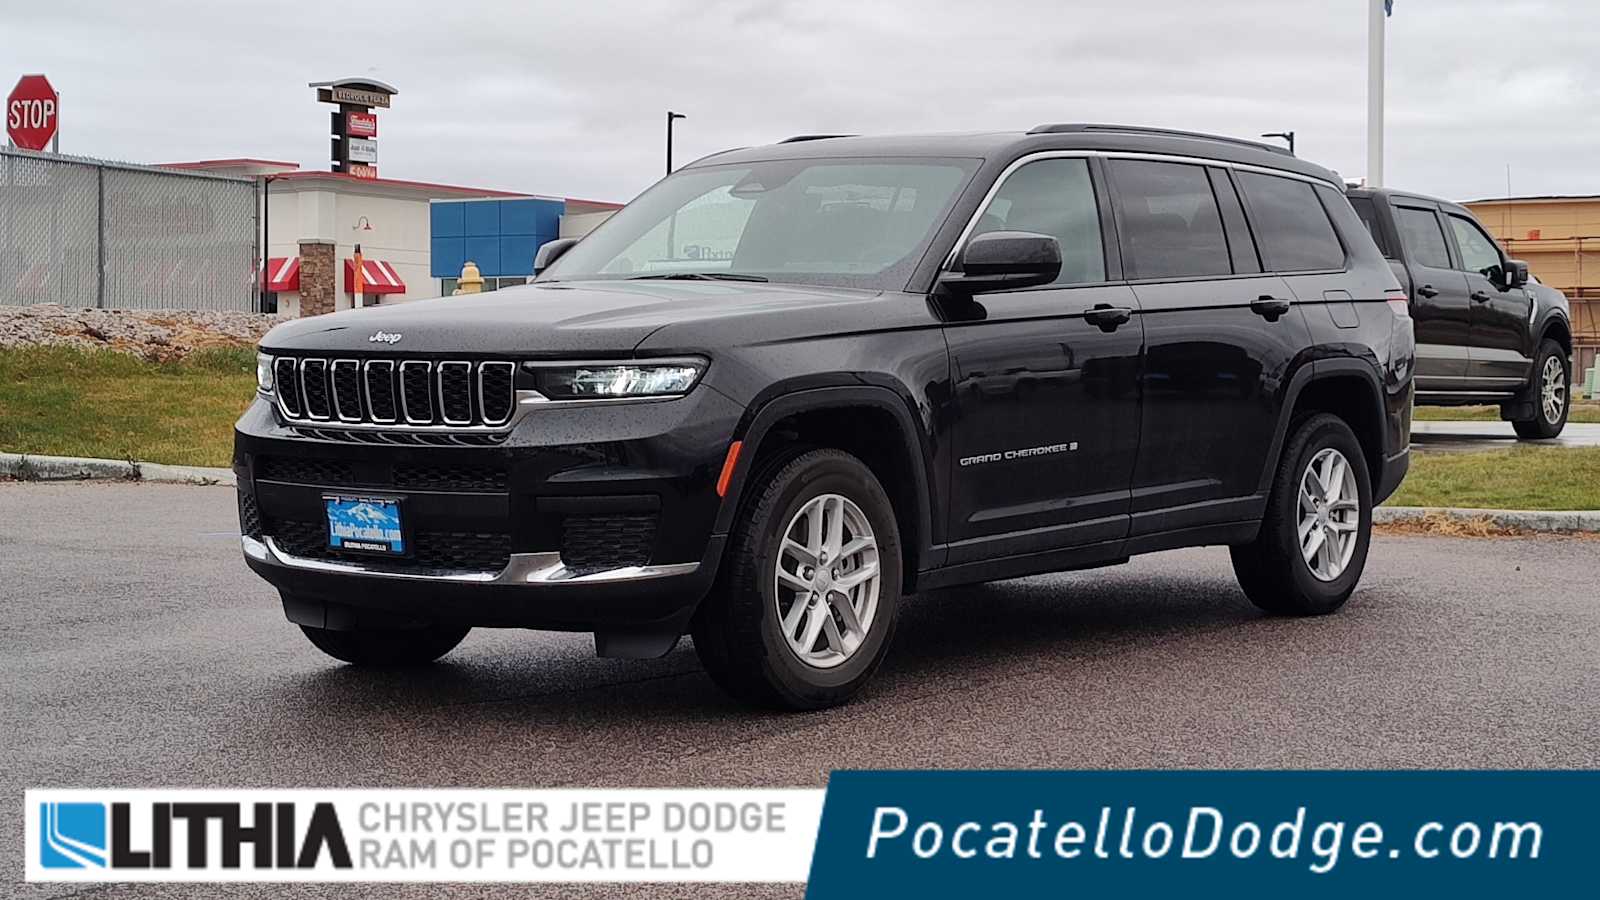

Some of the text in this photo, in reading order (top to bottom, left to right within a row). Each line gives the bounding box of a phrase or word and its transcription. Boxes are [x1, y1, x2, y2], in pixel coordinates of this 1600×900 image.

[9, 99, 55, 129] STOP
[369, 331, 402, 345] Jeep
[960, 453, 1001, 466] GRAND
[1004, 444, 1067, 459] CHEROKEE
